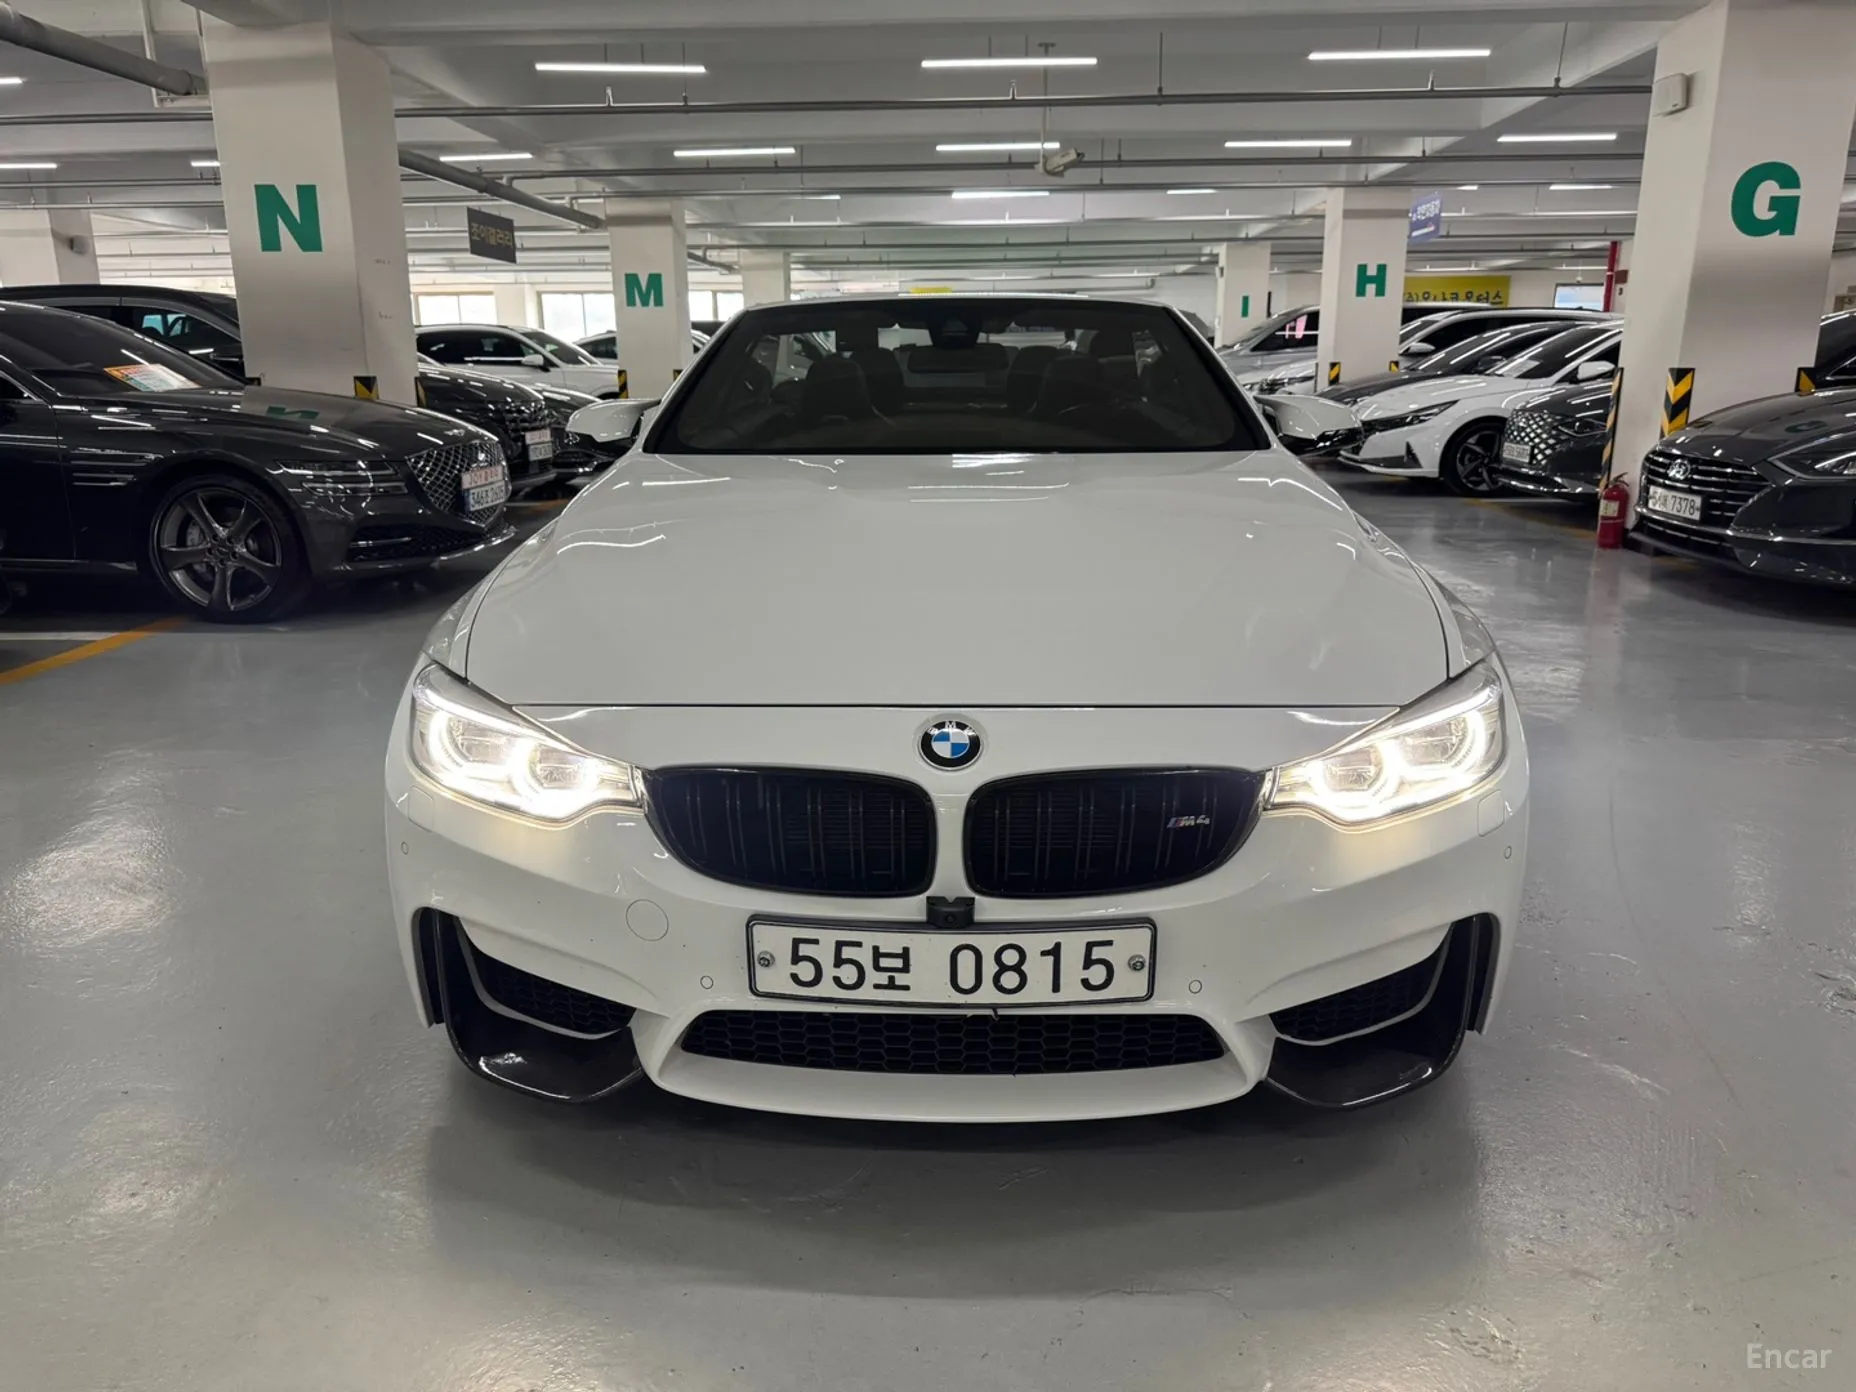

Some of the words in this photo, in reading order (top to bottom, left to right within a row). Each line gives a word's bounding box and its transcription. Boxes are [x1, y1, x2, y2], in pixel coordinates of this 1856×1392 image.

[1731, 161, 1802, 237] G
[254, 184, 323, 252] N
[624, 273, 664, 307] M
[1355, 263, 1387, 297] H
[1241, 295, 1249, 318] I
[1671, 495, 1696, 516] 7378
[926, 720, 977, 736] BMW
[789, 937, 911, 992] 55보
[949, 940, 1115, 995] 0815
